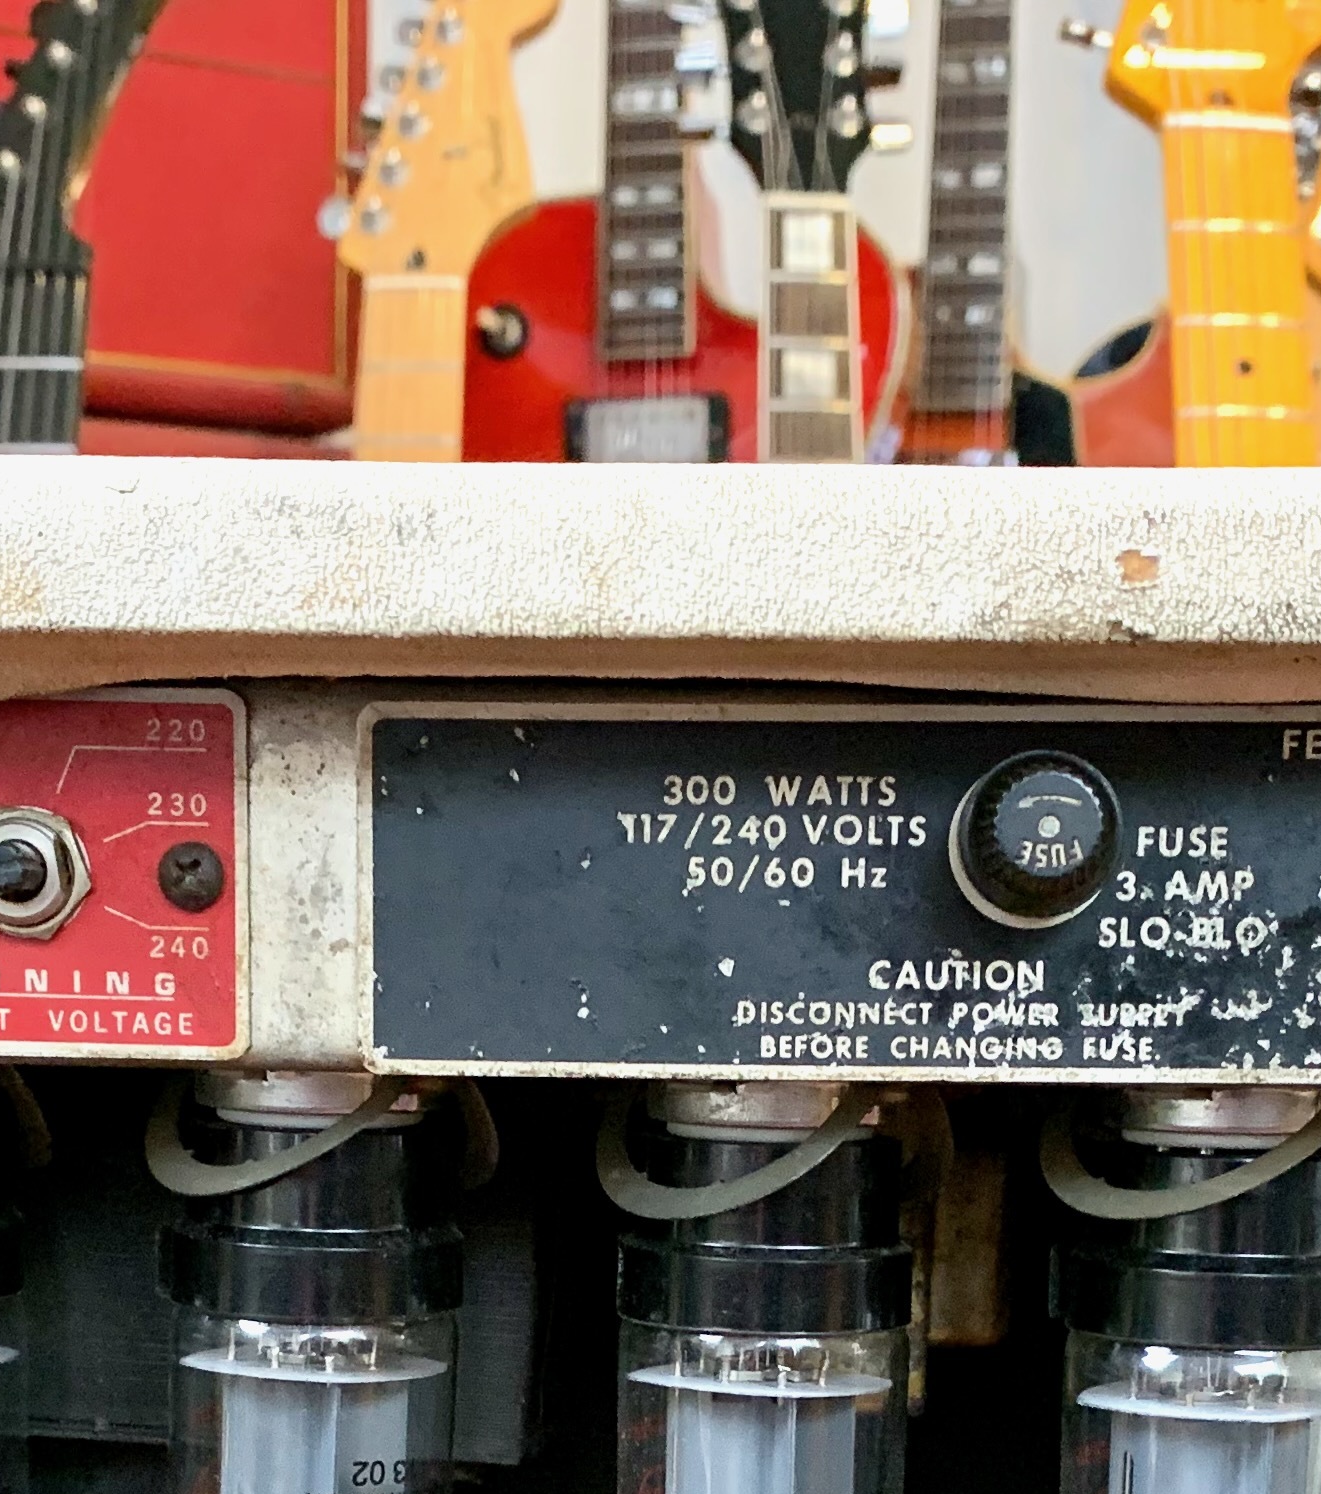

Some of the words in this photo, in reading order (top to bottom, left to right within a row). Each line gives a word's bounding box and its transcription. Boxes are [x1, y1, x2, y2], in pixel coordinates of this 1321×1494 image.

[147, 719, 206, 743] 220
[148, 791, 207, 817] 230
[664, 775, 736, 806] 300
[765, 775, 897, 807] WATTS
[617, 811, 787, 850] 117/240
[802, 814, 927, 847] VOLTS
[1136, 825, 1229, 858] FUSE
[1015, 838, 1084, 869] FUSE
[686, 854, 815, 893] 50/60
[841, 857, 888, 888] Hz
[1164, 869, 1256, 903] AMP
[150, 936, 209, 960] 240
[868, 959, 1045, 991] CAUTION
[48, 1011, 194, 1036] VOLTAGE
[736, 1000, 933, 1026] DISCONNECT
[952, 1001, 1059, 1027] POWER
[1080, 1001, 1192, 1028] SUPPLY
[760, 1034, 869, 1059] BEFORE
[890, 1036, 1064, 1062] CHANGING
[1082, 1036, 1162, 1061] FUSE.
[351, 1460, 386, 1487] 02
